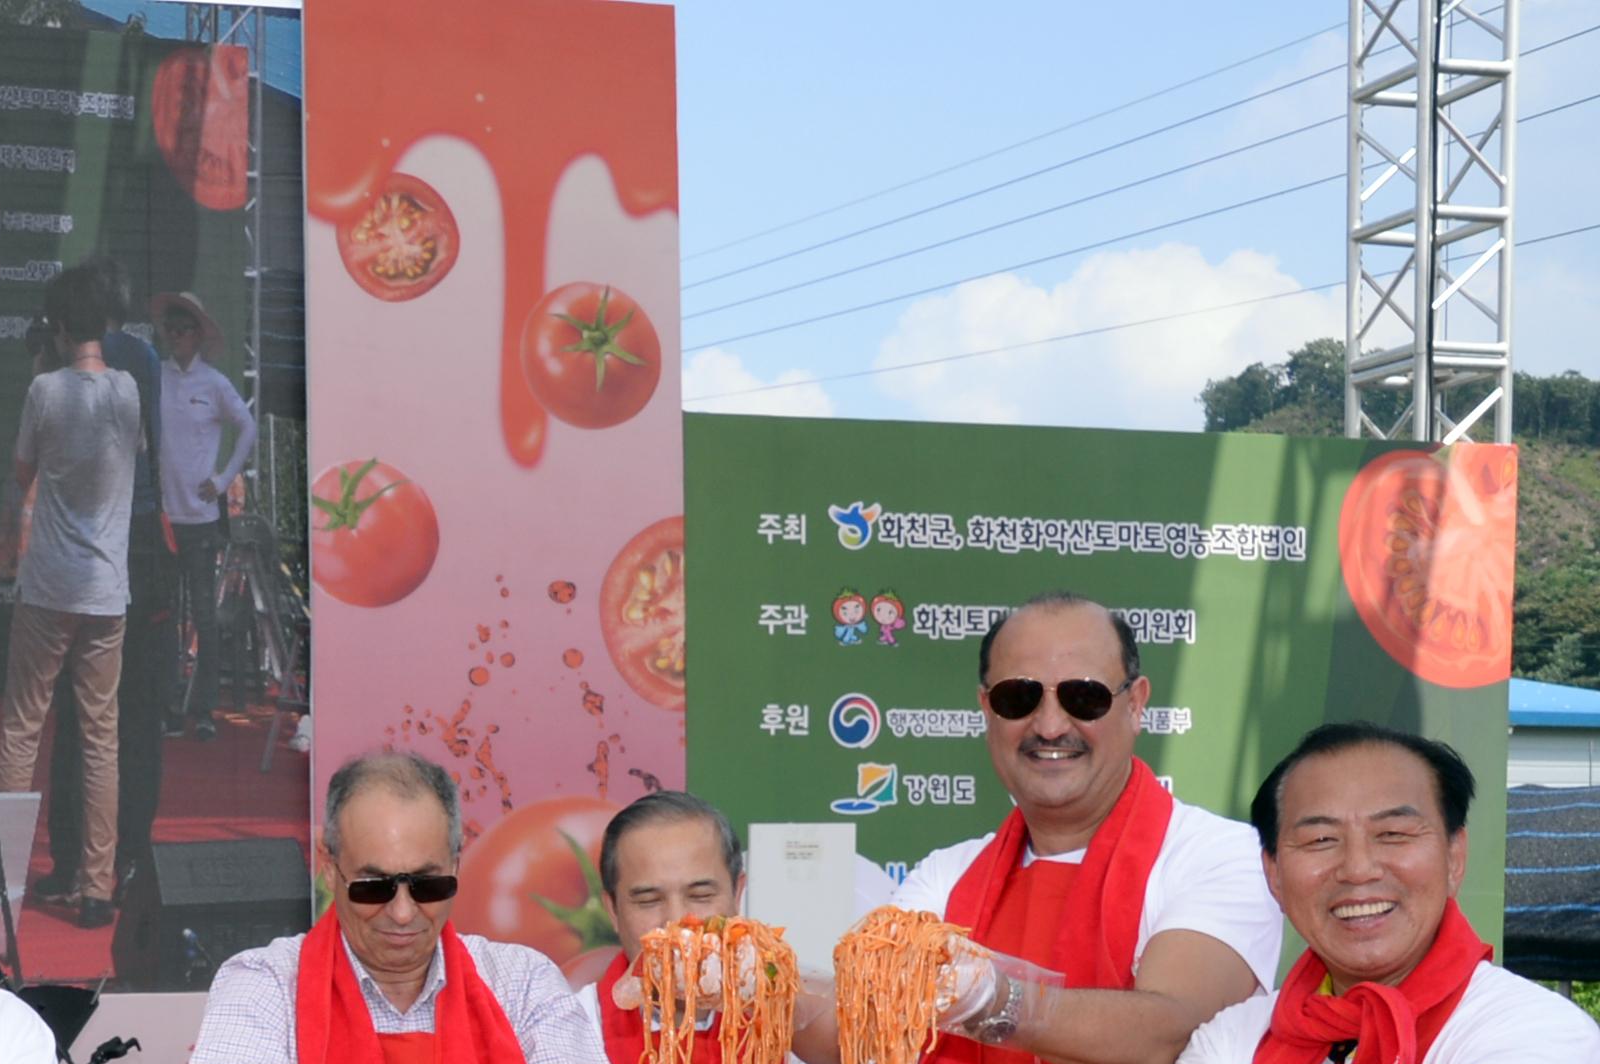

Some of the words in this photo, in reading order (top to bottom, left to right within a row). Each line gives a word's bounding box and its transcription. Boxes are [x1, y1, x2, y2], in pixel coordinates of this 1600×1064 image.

[757, 513, 807, 545] 주최
[878, 513, 962, 550] 화천군,
[967, 515, 1306, 560] 화천화악산토마토영농조합법인
[758, 604, 808, 635] 주관
[759, 704, 810, 736] 후원
[886, 708, 987, 737] 행정안전부
[902, 775, 976, 804] 강원도
